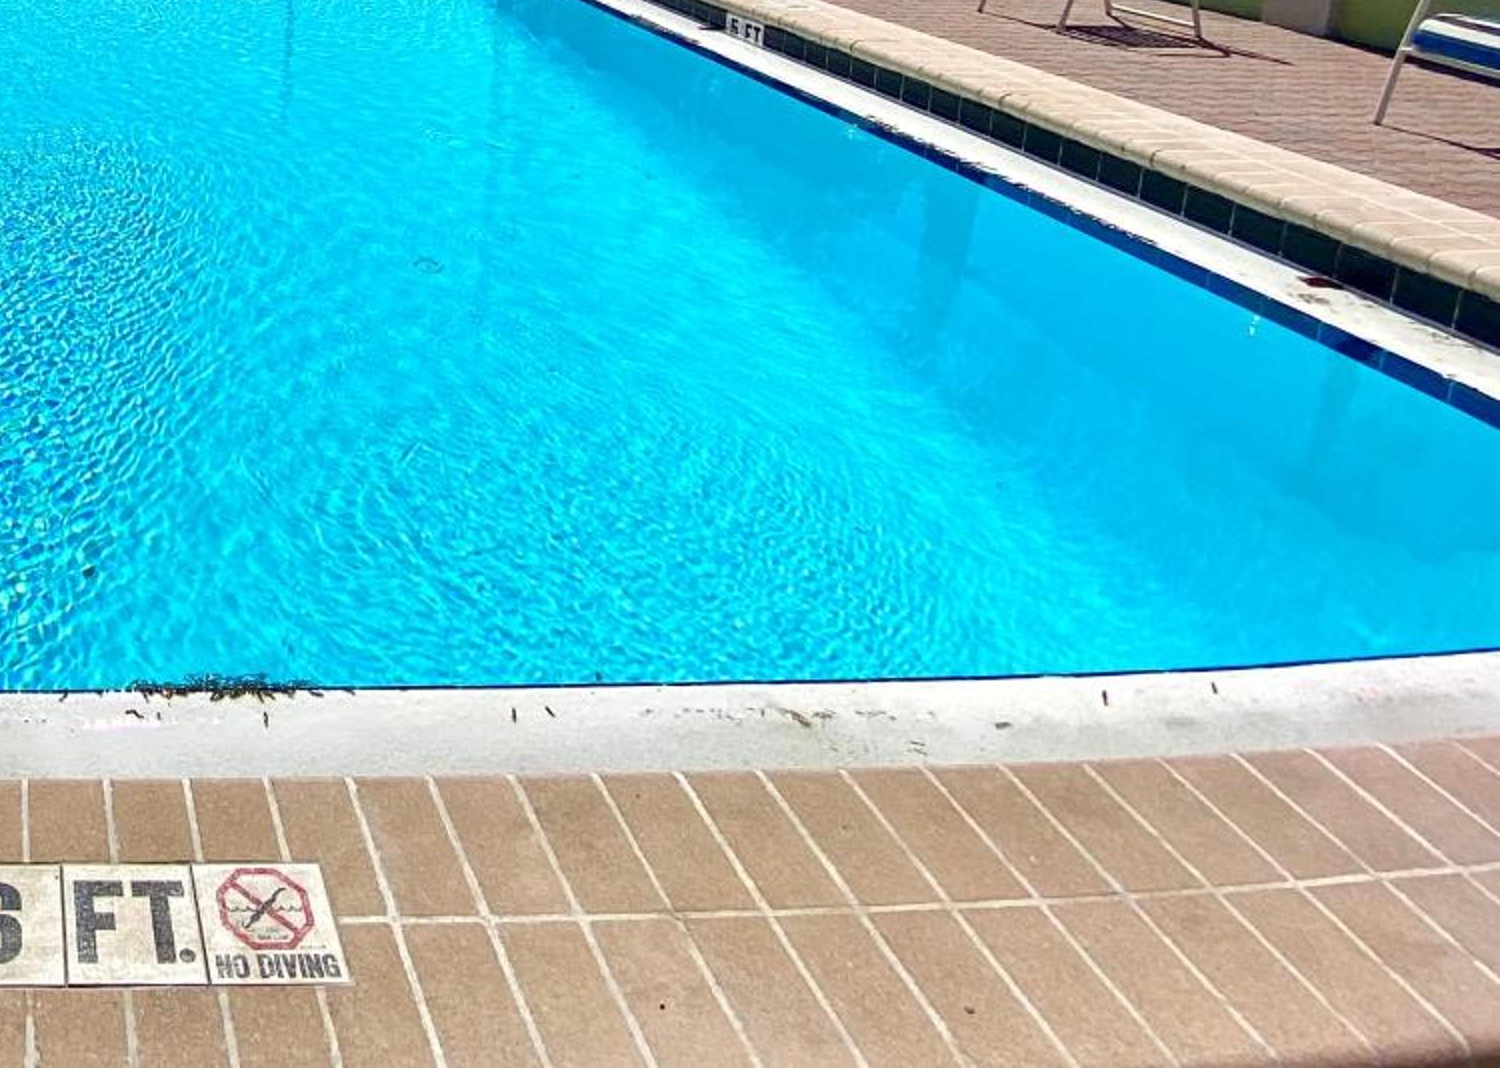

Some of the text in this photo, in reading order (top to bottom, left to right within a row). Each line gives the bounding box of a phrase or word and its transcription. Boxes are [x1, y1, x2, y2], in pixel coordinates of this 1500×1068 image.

[744, 23, 761, 43] FT
[72, 879, 197, 965] FT.
[215, 953, 343, 980] NO DIVING
